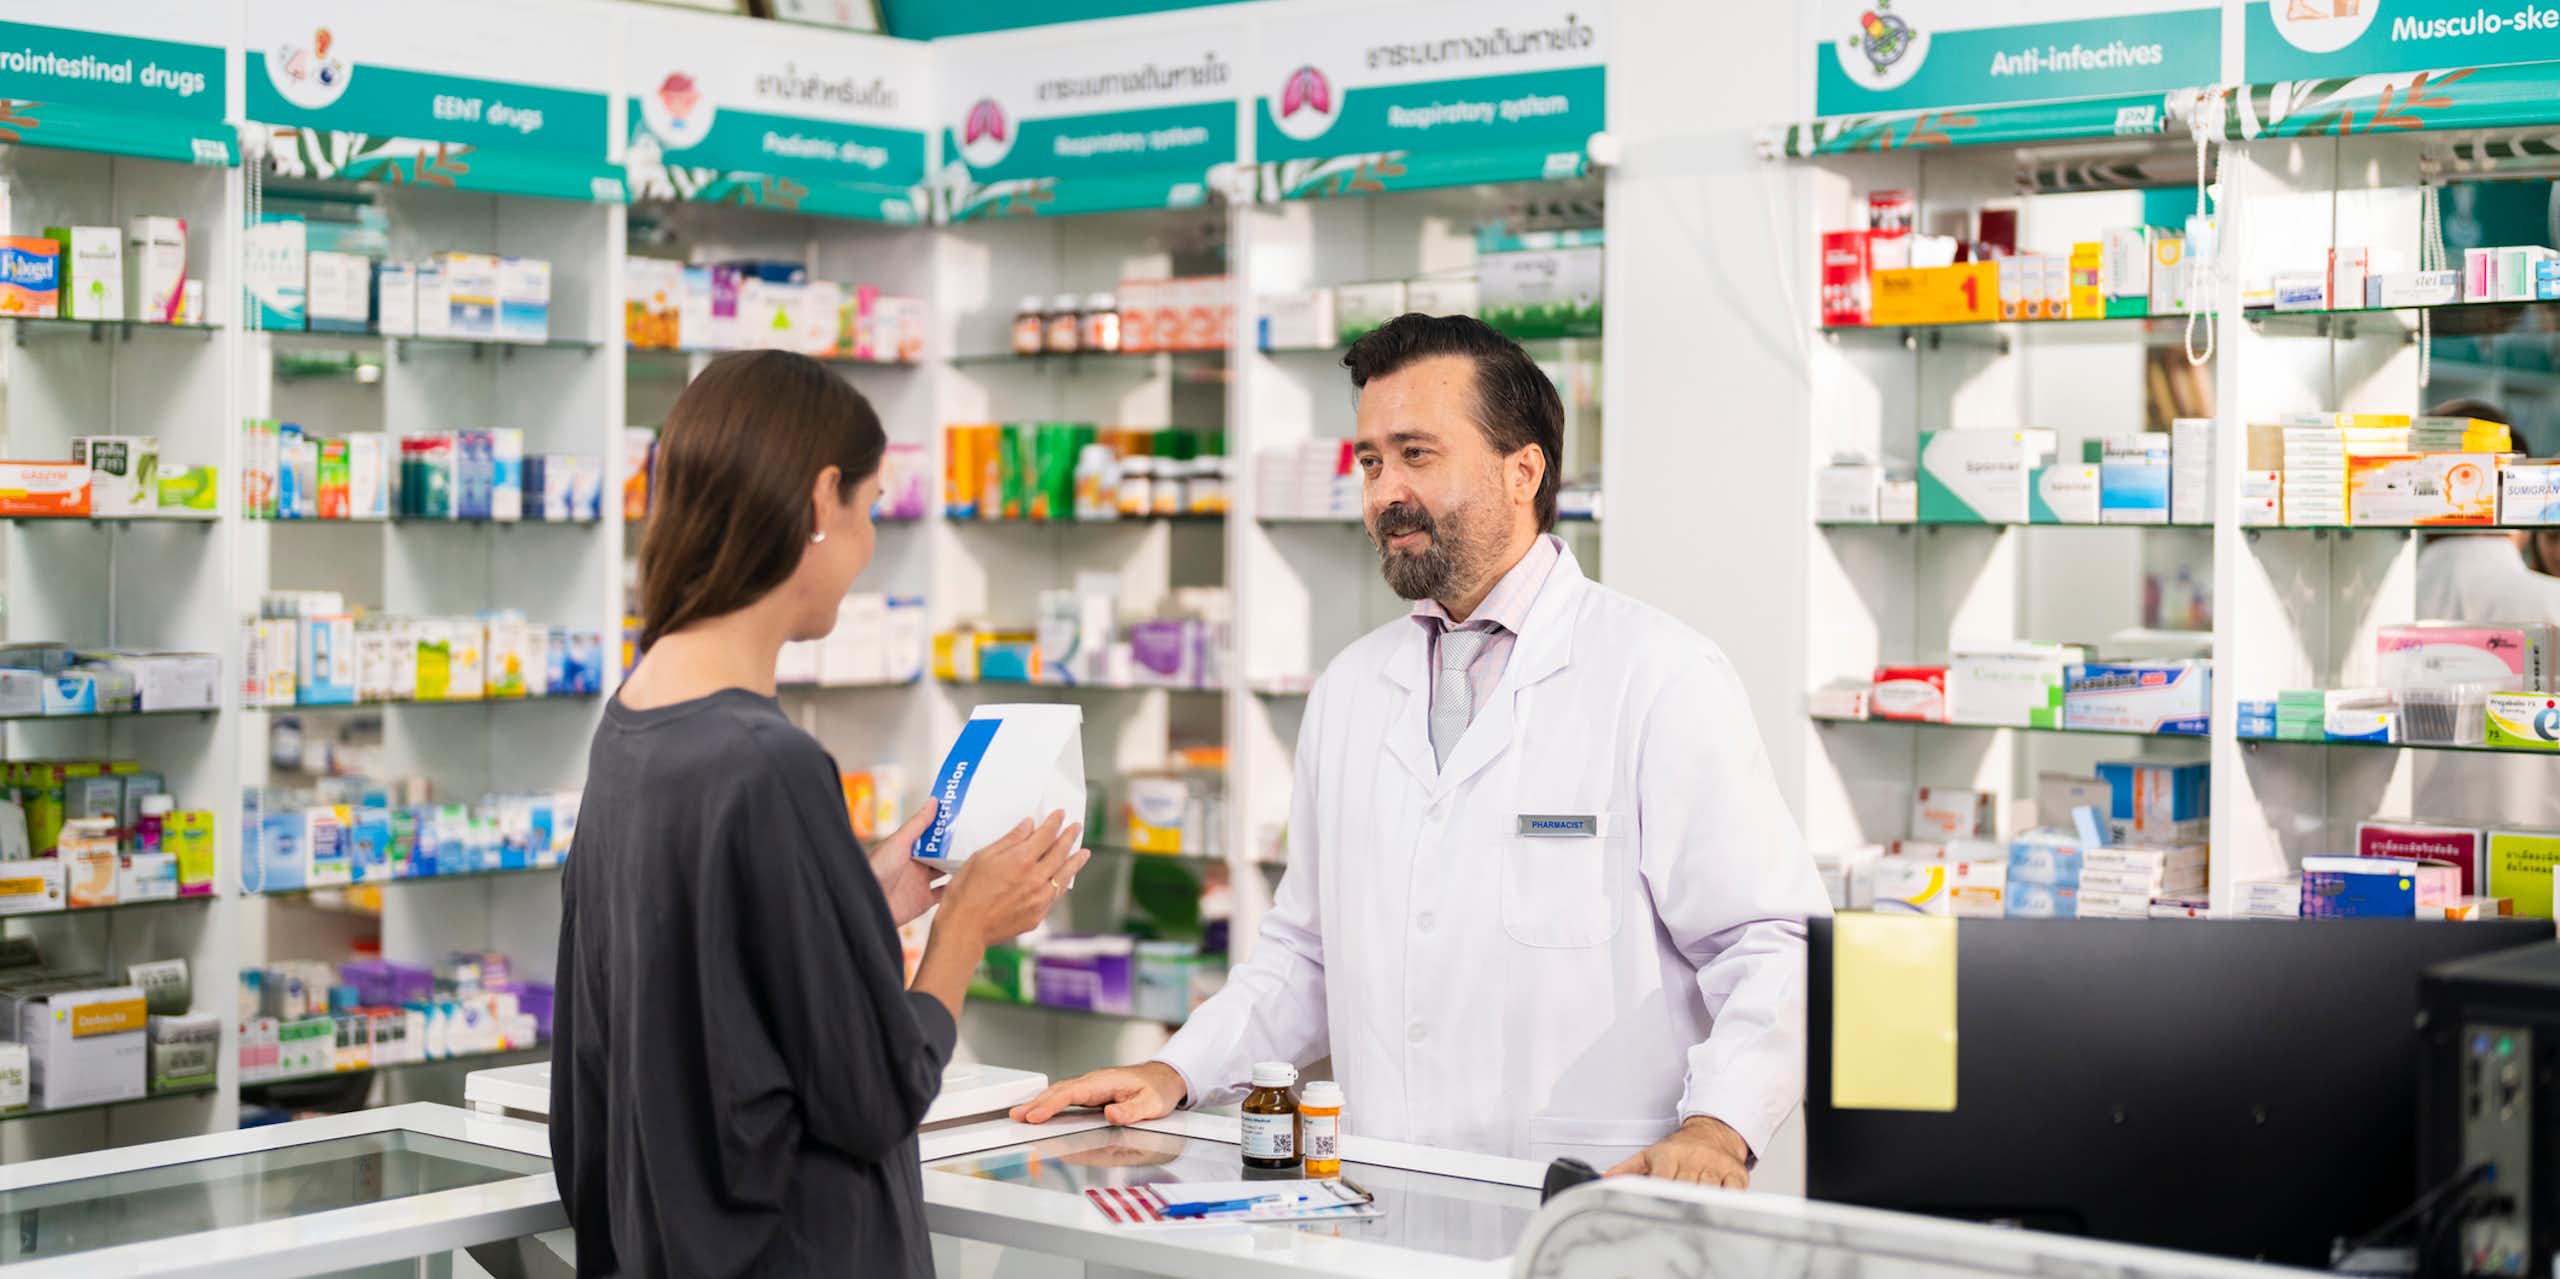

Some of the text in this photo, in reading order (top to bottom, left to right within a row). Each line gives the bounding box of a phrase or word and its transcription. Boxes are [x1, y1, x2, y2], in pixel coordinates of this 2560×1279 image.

[2391, 4, 2559, 42] Musculo-ske
[1990, 40, 2163, 77] Anti-infectives
[140, 62, 206, 97] drugs
[433, 94, 544, 134] EENT drugs
[1387, 93, 1569, 130] Respiratory system
[1960, 274, 1978, 312] 1
[925, 761, 968, 853] Prescription
[1531, 820, 1584, 829] PHARMACIST
